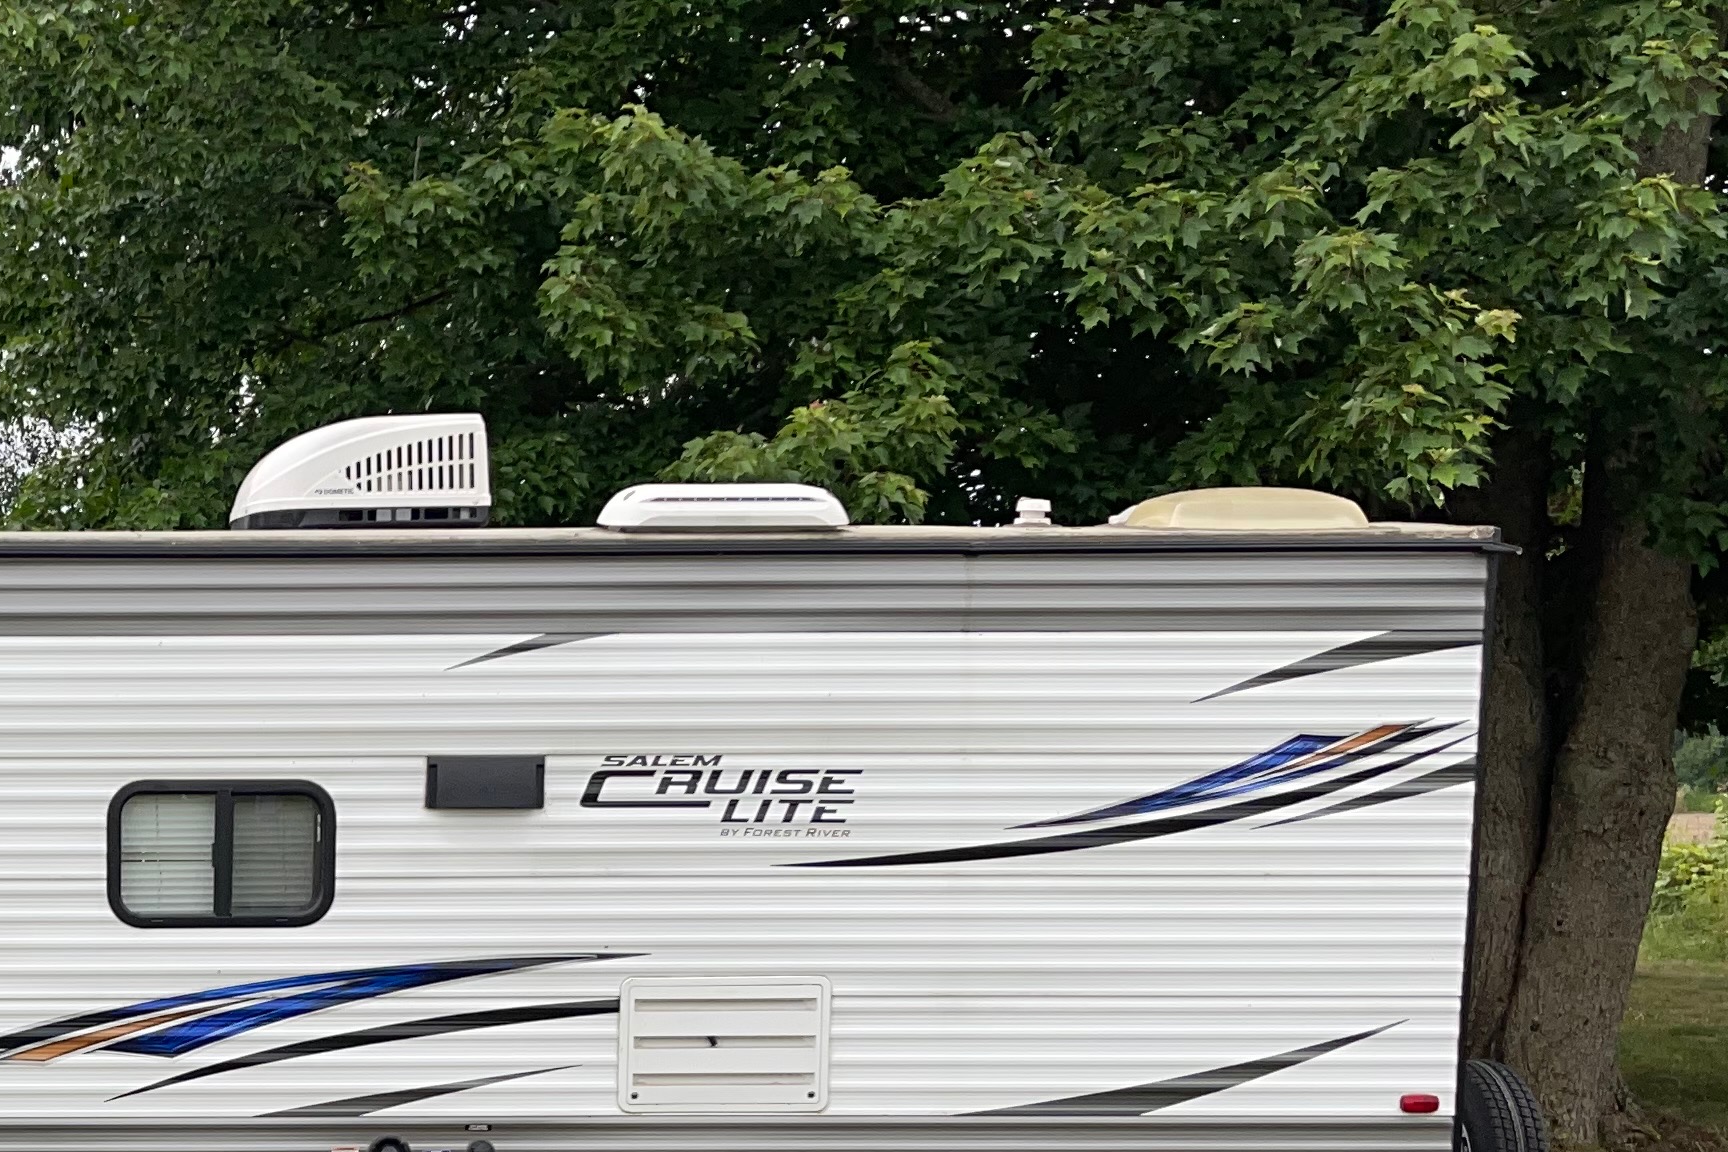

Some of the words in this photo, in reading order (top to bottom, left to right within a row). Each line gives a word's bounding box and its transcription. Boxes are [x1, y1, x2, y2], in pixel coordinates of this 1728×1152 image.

[601, 755, 722, 767] SALEM
[580, 769, 864, 807] CRUISE
[720, 799, 855, 823] LITE
[721, 828, 739, 837] BY
[743, 827, 802, 838] FOREST
[806, 828, 851, 838] RIVER
